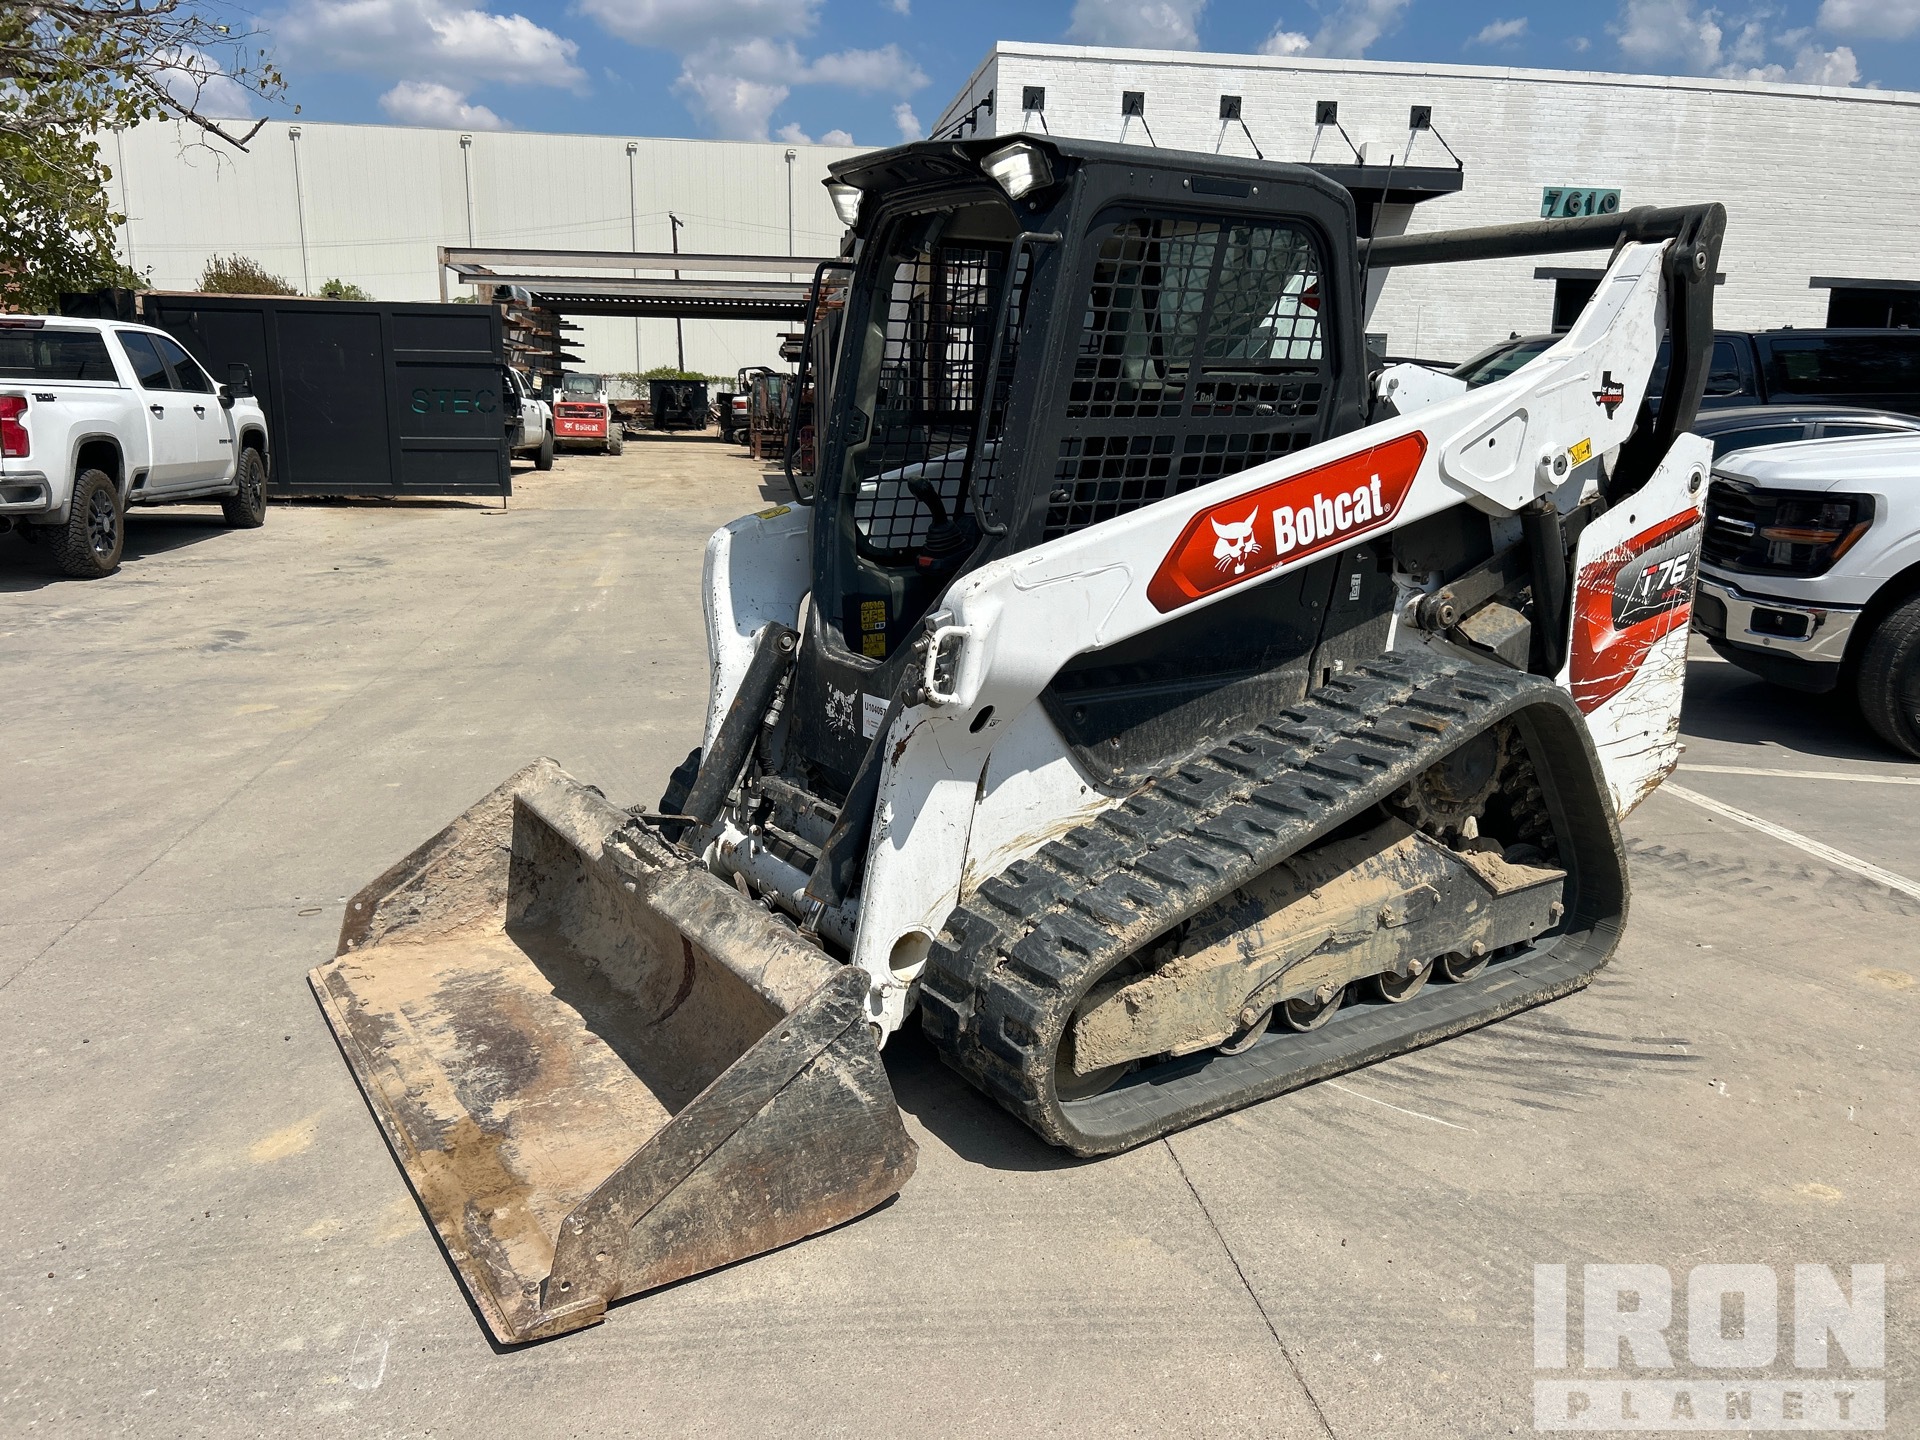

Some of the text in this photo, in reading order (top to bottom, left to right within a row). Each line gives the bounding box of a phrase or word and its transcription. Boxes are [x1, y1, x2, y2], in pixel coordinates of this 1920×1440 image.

[1547, 190, 1619, 213] 7610
[411, 388, 497, 413] STEC
[575, 423, 599, 431] Bobcat
[1272, 473, 1384, 555] Bobcat
[1641, 552, 1690, 596] T76
